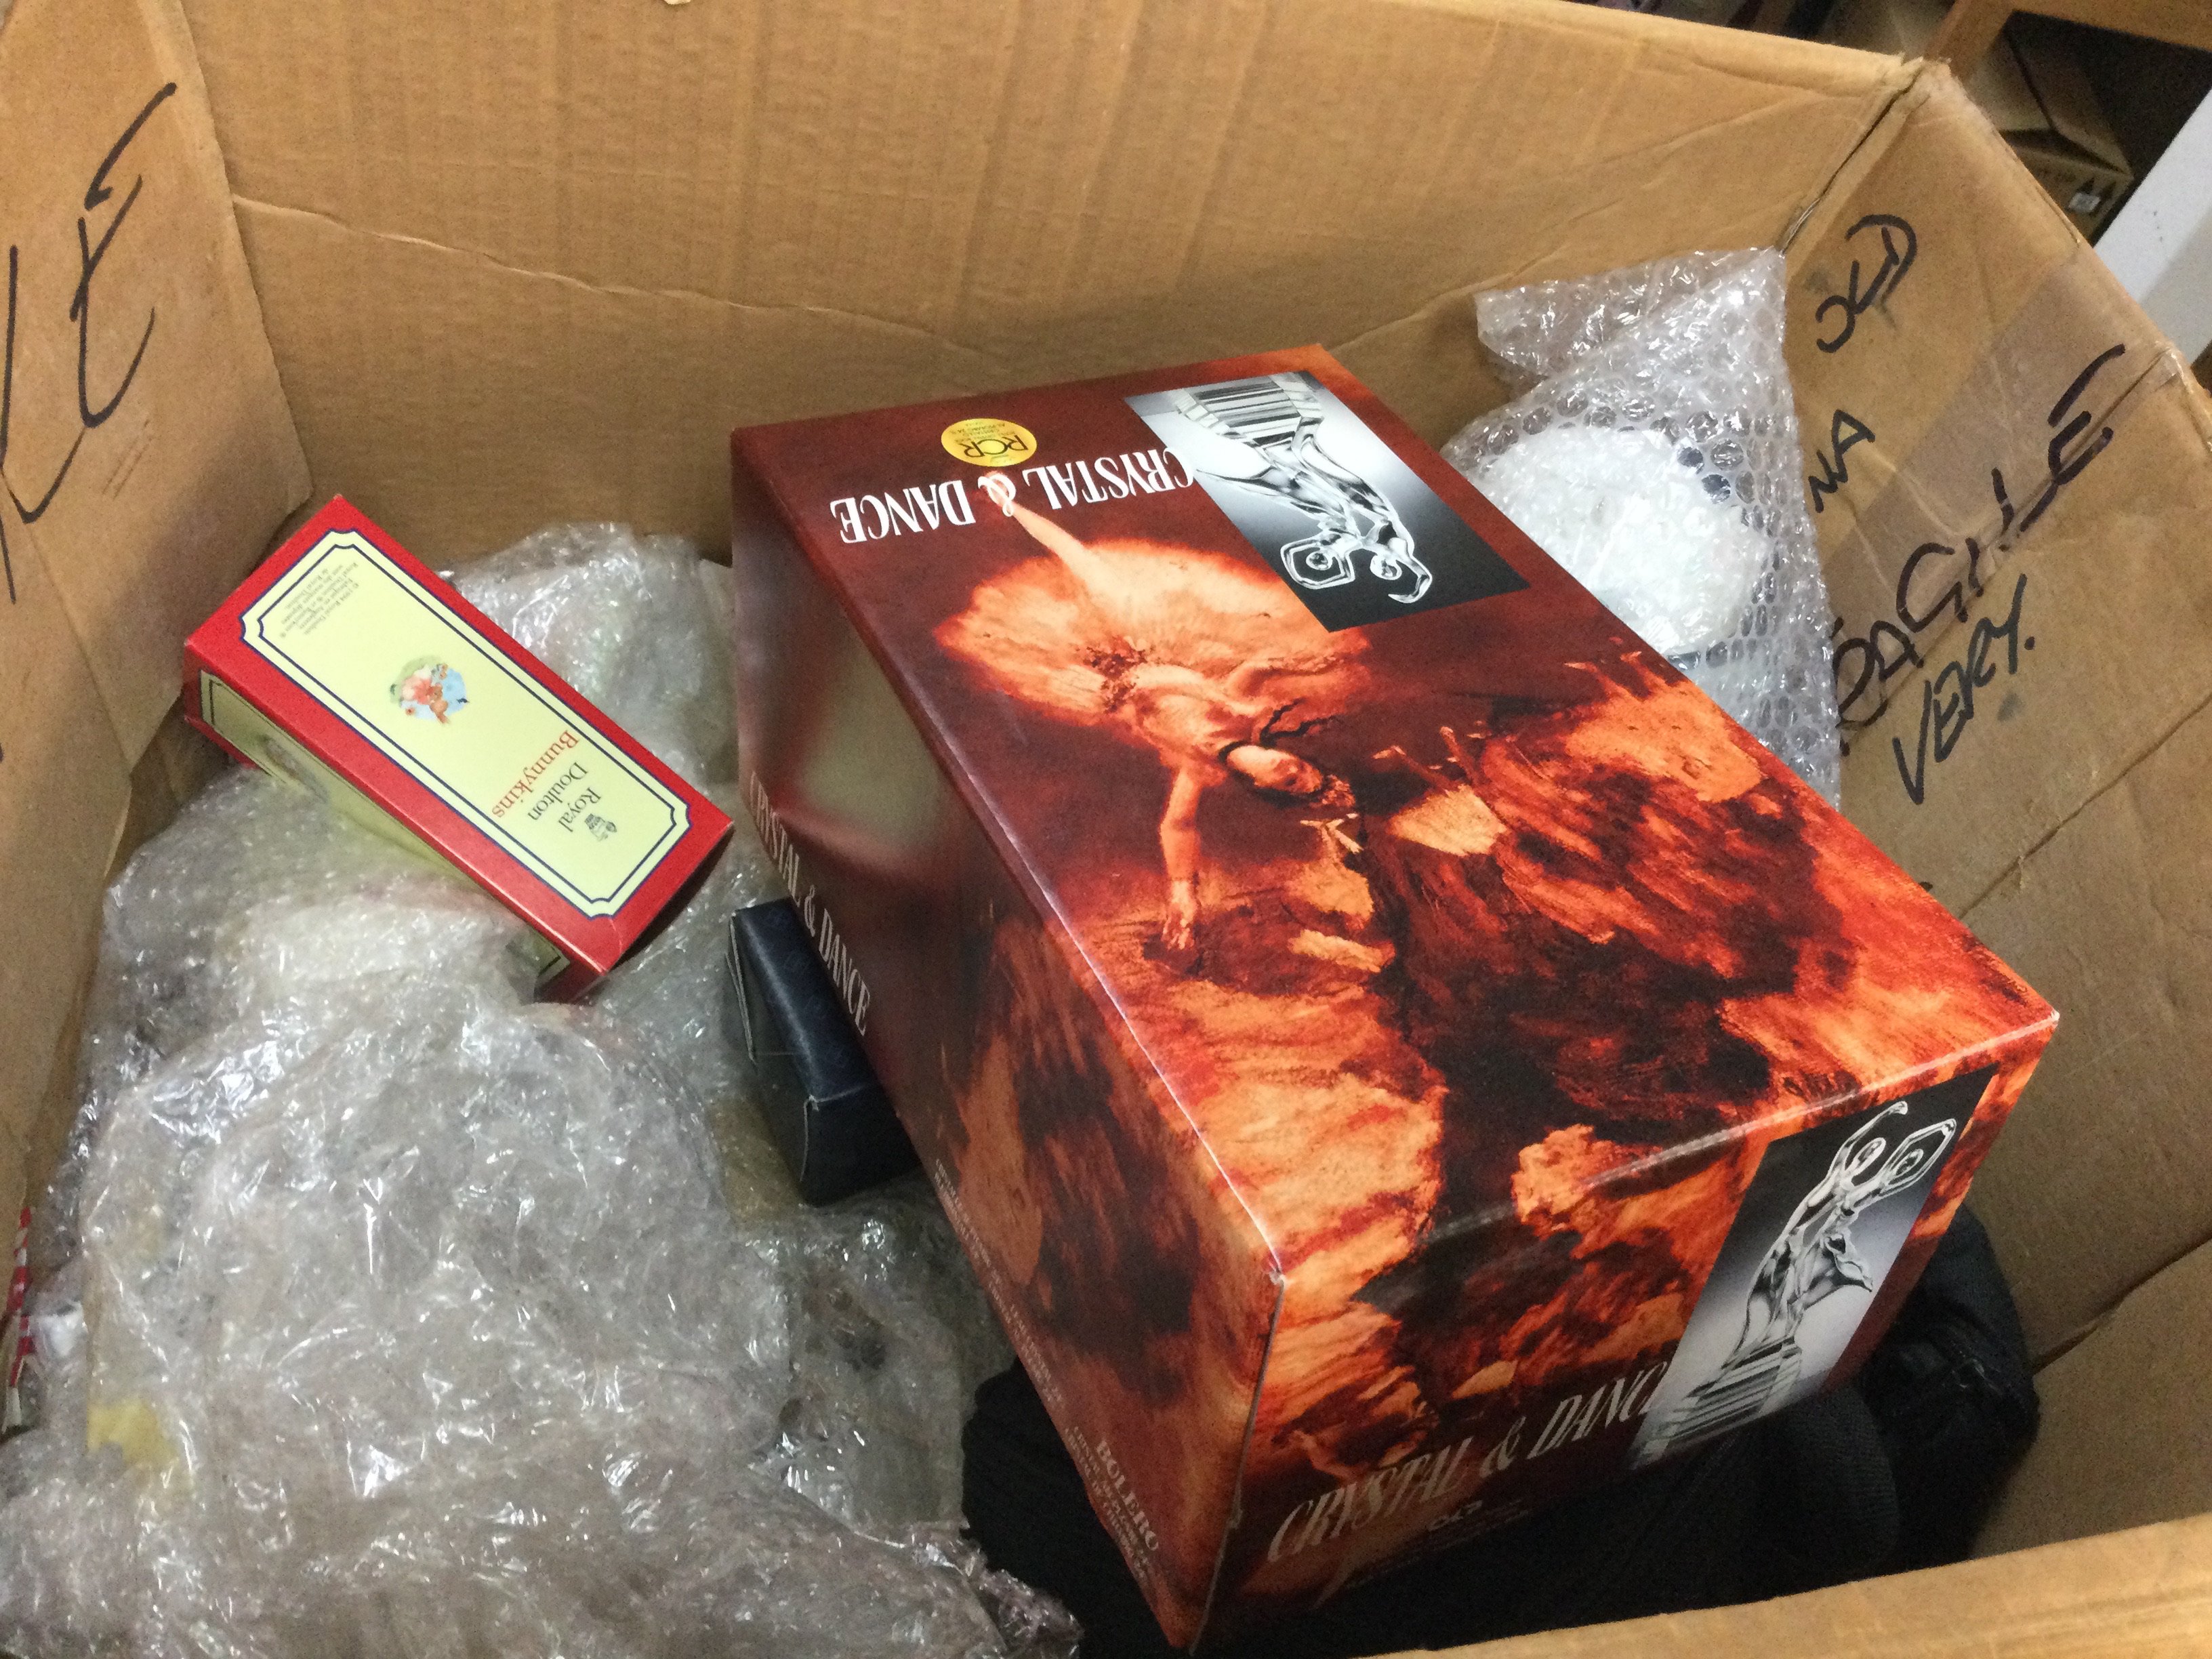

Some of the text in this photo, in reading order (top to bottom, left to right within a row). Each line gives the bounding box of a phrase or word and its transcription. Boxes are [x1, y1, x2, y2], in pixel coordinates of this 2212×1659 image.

[958, 434, 1029, 458] RCR
[830, 447, 1196, 544] CRYSTAL & DANCE
[491, 729, 581, 819] Bunnykins
[527, 761, 589, 821] Doulton
[557, 786, 602, 834] Royal
[818, 907, 871, 1037] DANCE
[1266, 1435, 1475, 1560] CRYSTAL
[1479, 1415, 1527, 1478] &
